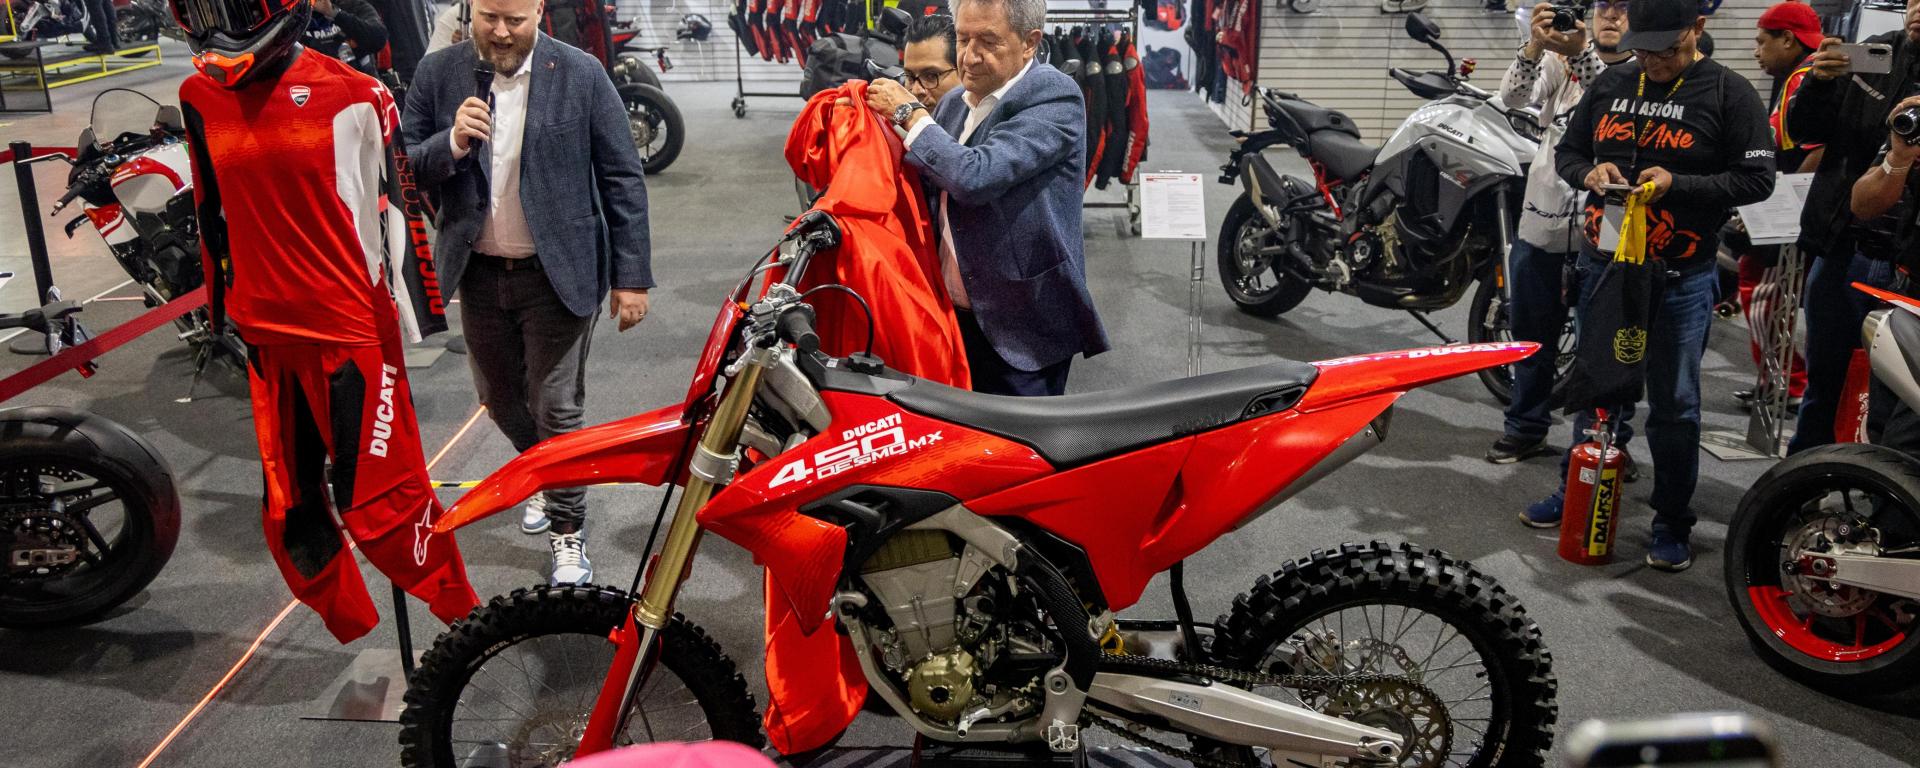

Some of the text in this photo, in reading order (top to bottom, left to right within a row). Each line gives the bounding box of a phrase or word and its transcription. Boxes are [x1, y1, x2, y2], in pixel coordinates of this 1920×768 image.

[1611, 98, 1628, 112] LA
[1437, 122, 1464, 137] DUCATI
[1745, 149, 1767, 158] EXPO
[408, 220, 445, 315] DUCATI
[1408, 341, 1521, 358] DUCATI
[369, 362, 398, 458] DUCATI
[842, 412, 902, 441] DUCATI
[768, 426, 906, 489] 450
[816, 430, 943, 480] DESMO MX
